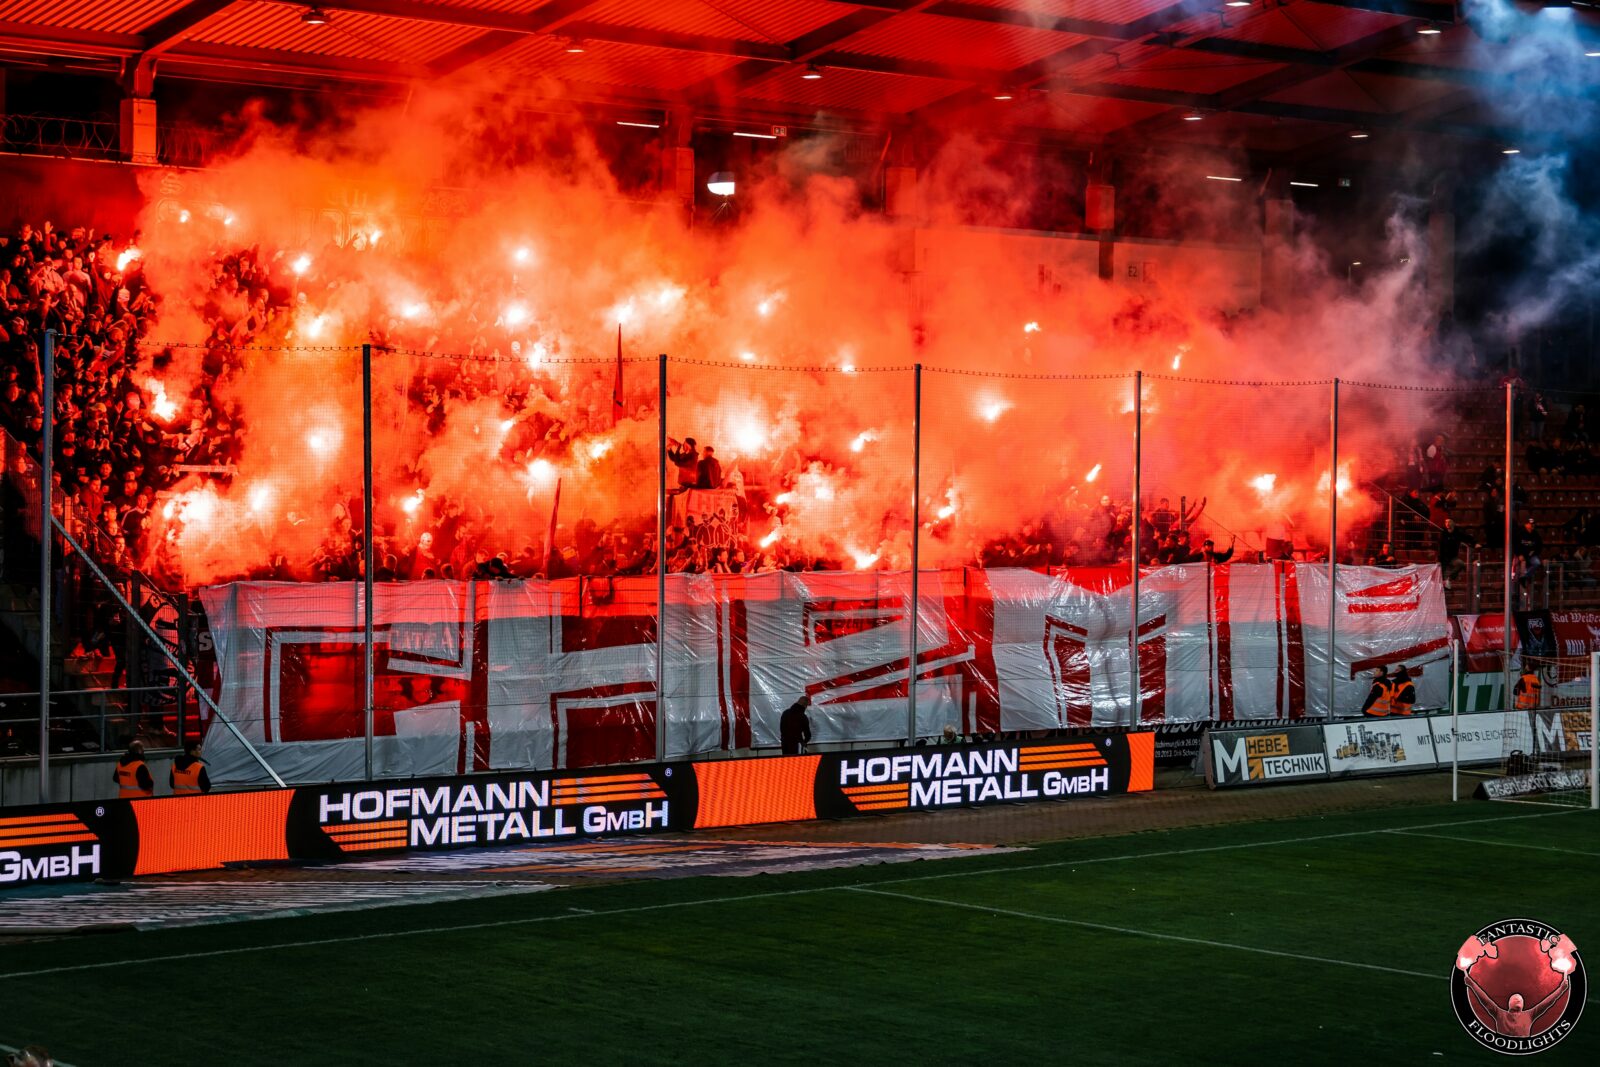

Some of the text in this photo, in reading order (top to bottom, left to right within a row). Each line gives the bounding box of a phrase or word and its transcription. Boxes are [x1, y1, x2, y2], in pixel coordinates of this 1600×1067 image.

[1247, 736, 1288, 755] HEBE-
[1417, 735, 1431, 745] MIT
[1436, 734, 1451, 744] UNS
[839, 747, 1020, 786] HOFMANN
[1265, 755, 1325, 776] TECHNIK
[319, 780, 550, 823] HOFMANN
[909, 774, 1038, 808] METALL
[410, 809, 577, 848] METALL
